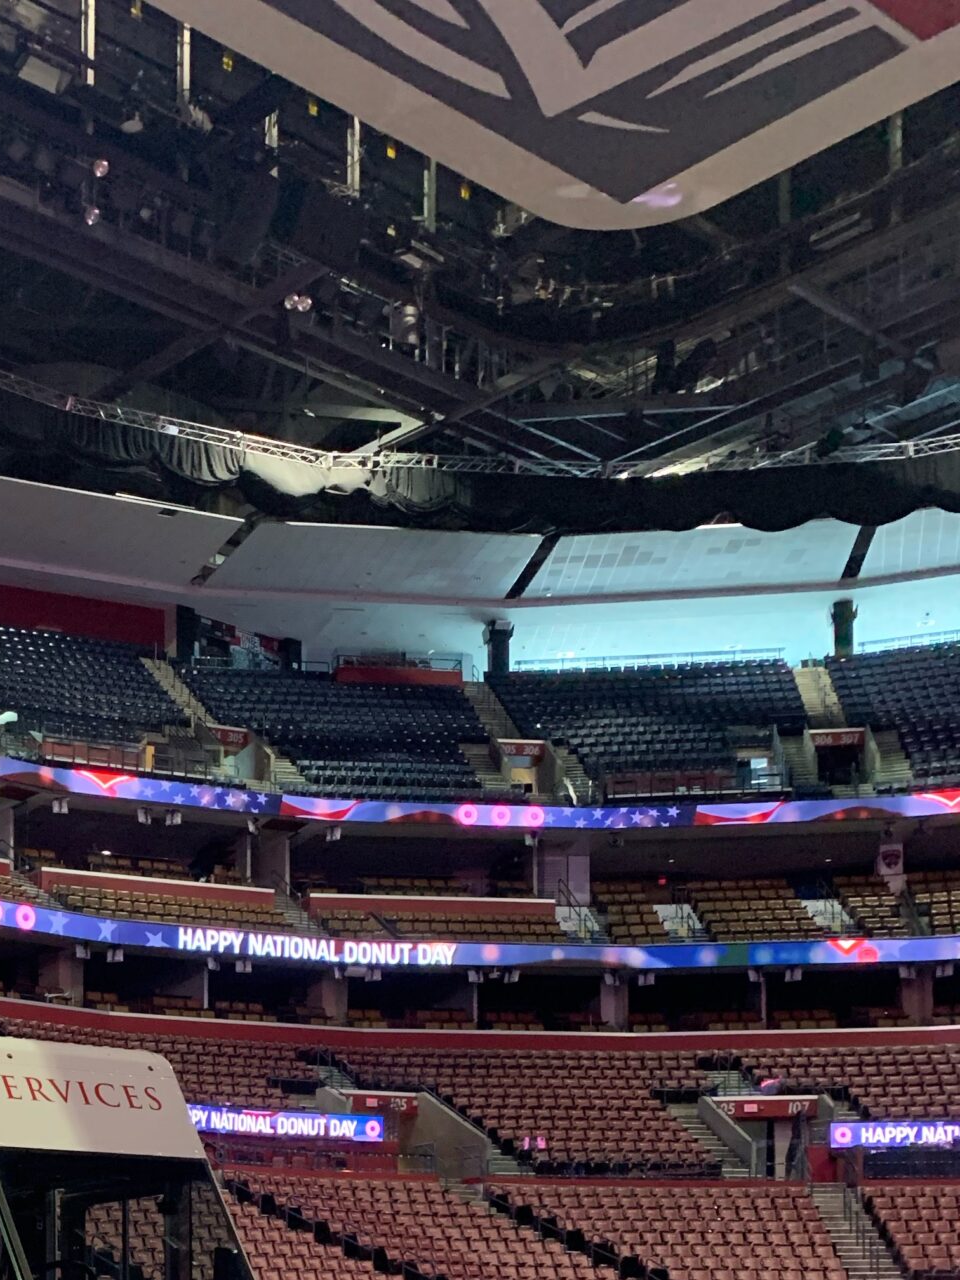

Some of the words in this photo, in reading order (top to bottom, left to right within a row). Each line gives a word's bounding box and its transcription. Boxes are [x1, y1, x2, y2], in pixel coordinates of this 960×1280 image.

[178, 926, 243, 955] HAPPY
[248, 935, 339, 962] NATIONAL
[343, 941, 412, 966] DONUT
[416, 943, 456, 967] DAY
[211, 1112, 275, 1134] NATIONAL
[277, 1116, 327, 1136] DONUT
[329, 1120, 358, 1138] DAY
[861, 1127, 918, 1144] HAPPY
